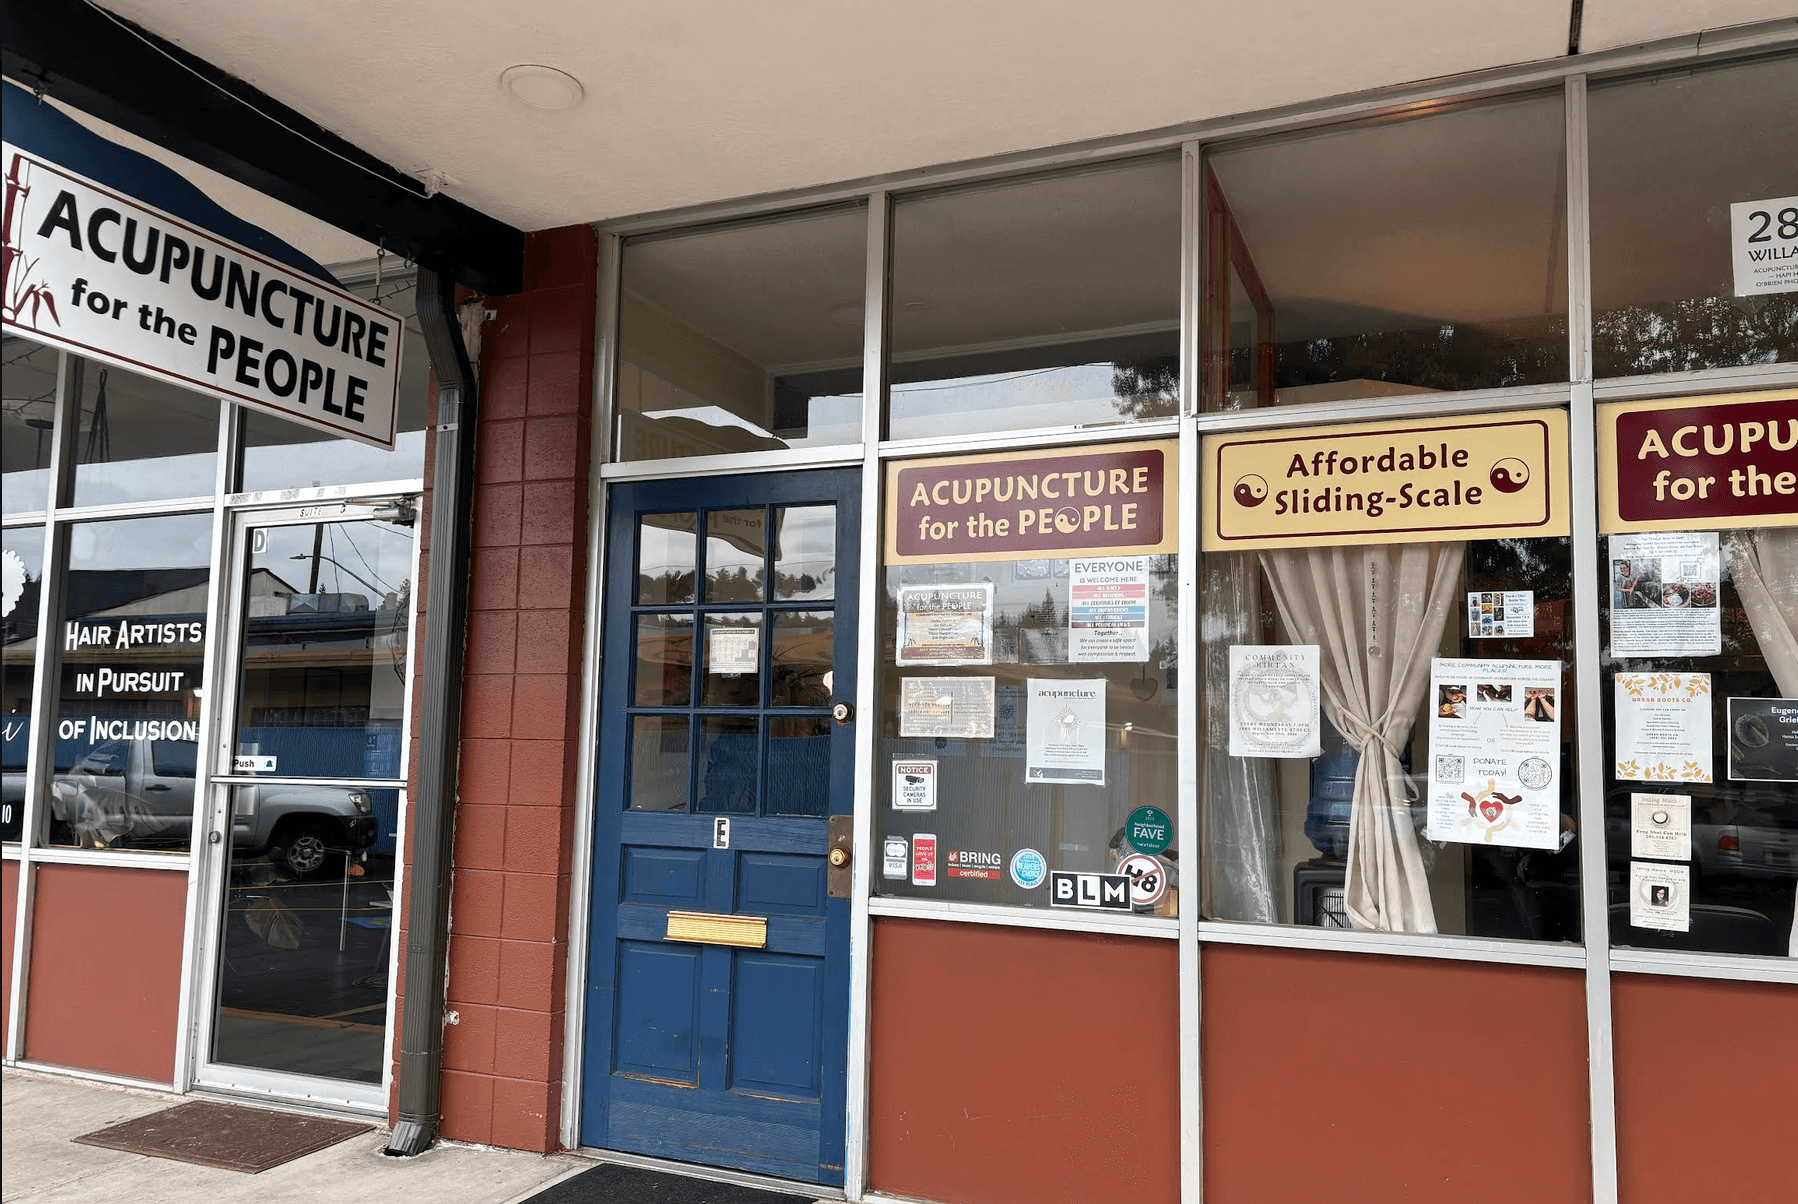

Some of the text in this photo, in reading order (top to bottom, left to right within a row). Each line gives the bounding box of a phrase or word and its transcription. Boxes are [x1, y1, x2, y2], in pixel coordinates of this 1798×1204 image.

[37, 189, 389, 368] ACUPUNCTURE
[71, 277, 369, 424] for the PEOPLE
[1286, 442, 1469, 479] Affordable
[910, 466, 1149, 507] ACUPUNCTURE
[1652, 464, 1797, 502] for the
[1275, 479, 1483, 518] Sliding-Scale
[300, 506, 323, 518] SUITE
[919, 515, 959, 541] for
[967, 512, 1009, 538] the
[253, 529, 267, 553] D
[1075, 560, 1143, 574] EVERYONE
[1087, 576, 1119, 584] WELCOME
[1120, 575, 1138, 583] HERE
[907, 591, 983, 601] ACUPUNCTURE
[65, 620, 202, 651] HAIR ARTISTS
[76, 667, 184, 698] IN PURSUIT
[1038, 689, 1096, 699] acupuncture
[58, 715, 198, 746] OF INCLUSION
[234, 757, 255, 769] Push
[899, 766, 930, 774] NOTICE
[1473, 757, 1507, 766] DONATE
[716, 819, 727, 847] E
[1133, 826, 1165, 840] FAVE
[959, 851, 1001, 866] BRING
[959, 869, 989, 878] certified
[1057, 877, 1126, 903] BLM
